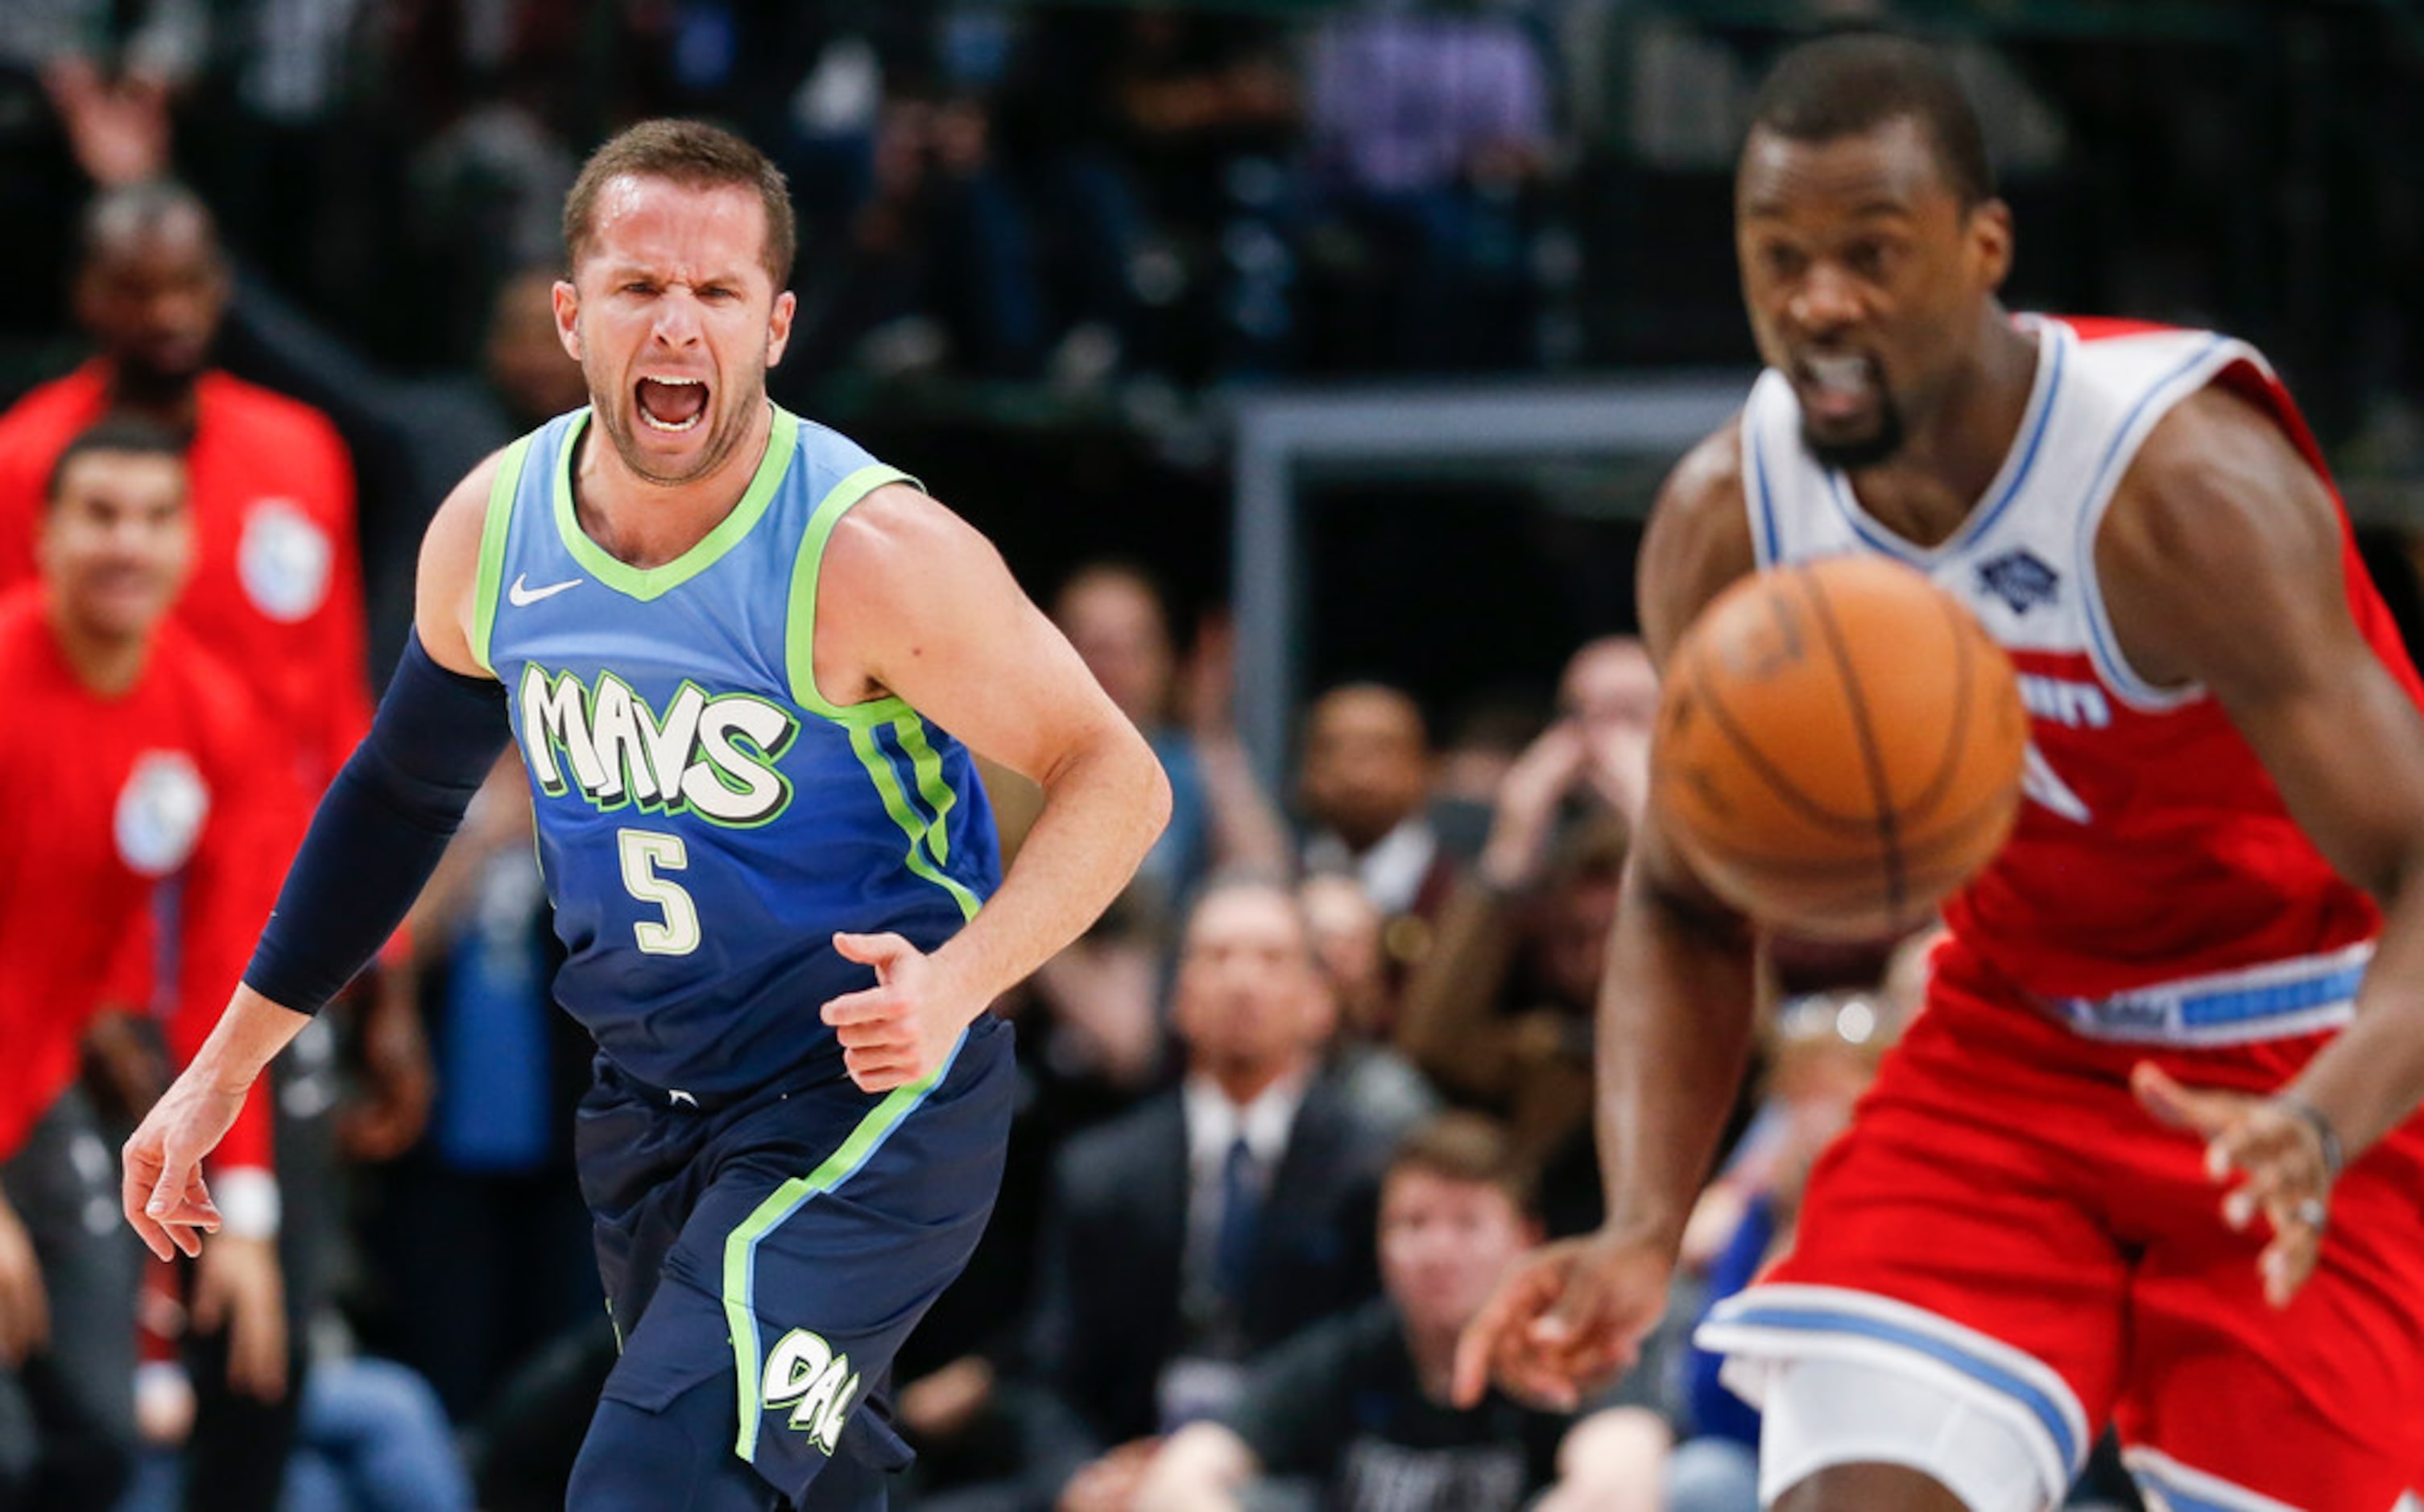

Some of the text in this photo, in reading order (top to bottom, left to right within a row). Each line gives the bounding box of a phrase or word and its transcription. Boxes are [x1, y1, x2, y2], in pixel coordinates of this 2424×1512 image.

[519, 660, 801, 828] MAVS
[617, 828, 701, 956] 5
[762, 1327, 860, 1456] DAL
